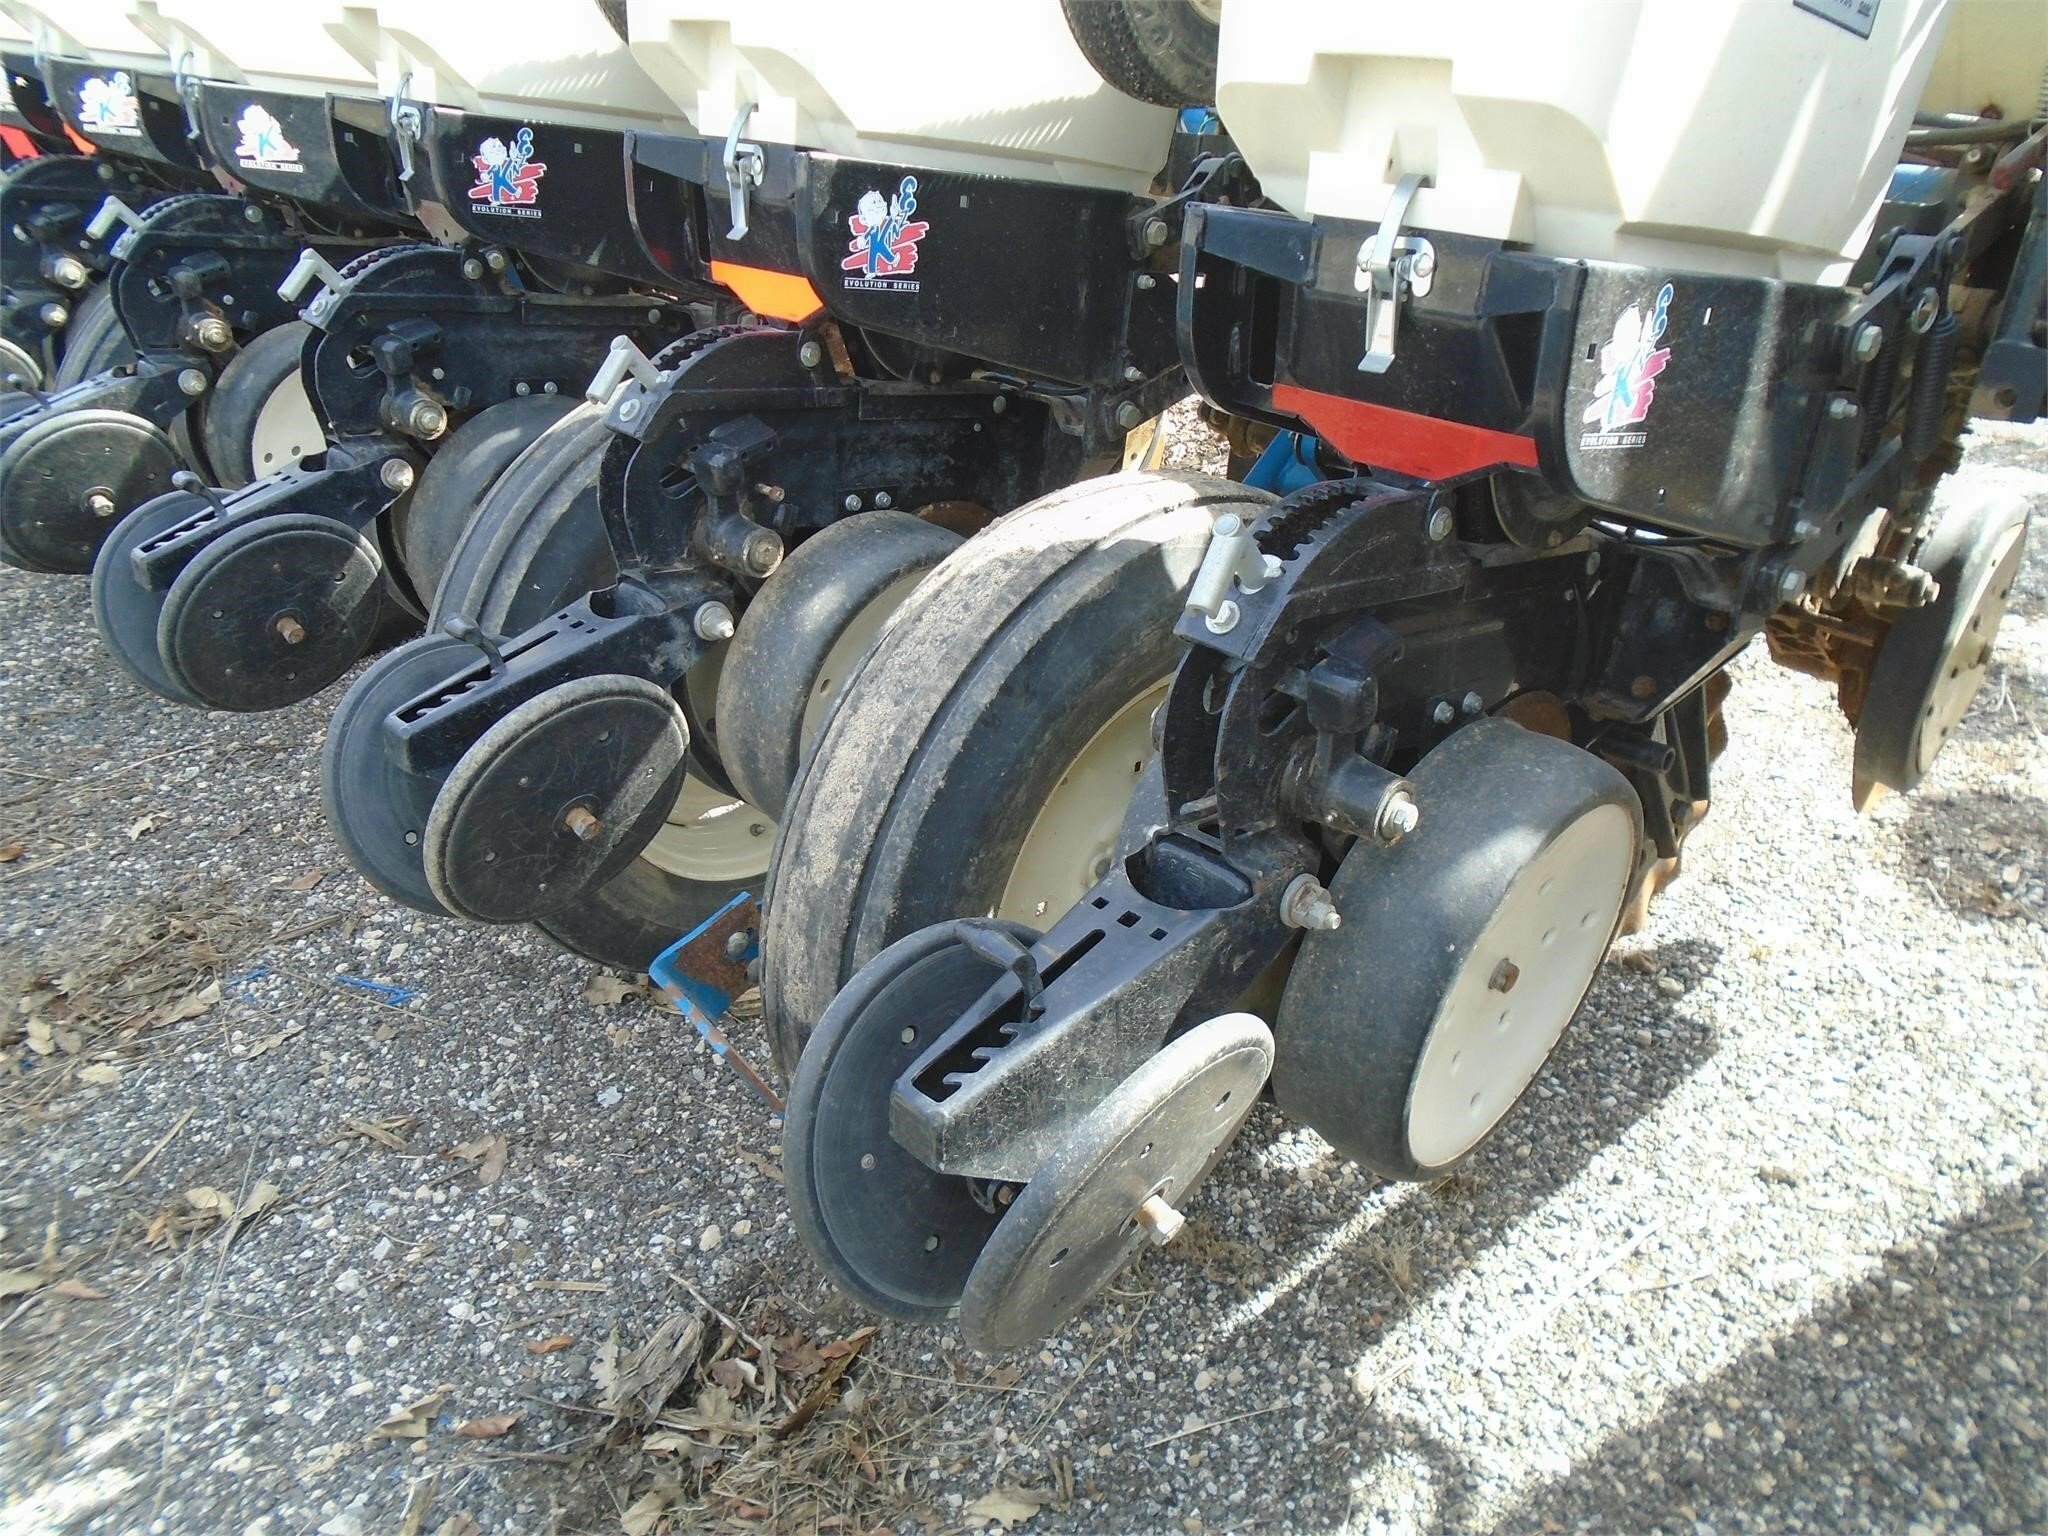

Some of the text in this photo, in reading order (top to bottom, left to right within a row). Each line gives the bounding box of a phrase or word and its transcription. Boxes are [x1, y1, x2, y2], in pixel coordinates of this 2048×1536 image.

[472, 205, 512, 214] EVOLUTION
[844, 279, 920, 290] EVOLUTION SERIES
[1622, 435, 1647, 445] SERIES
